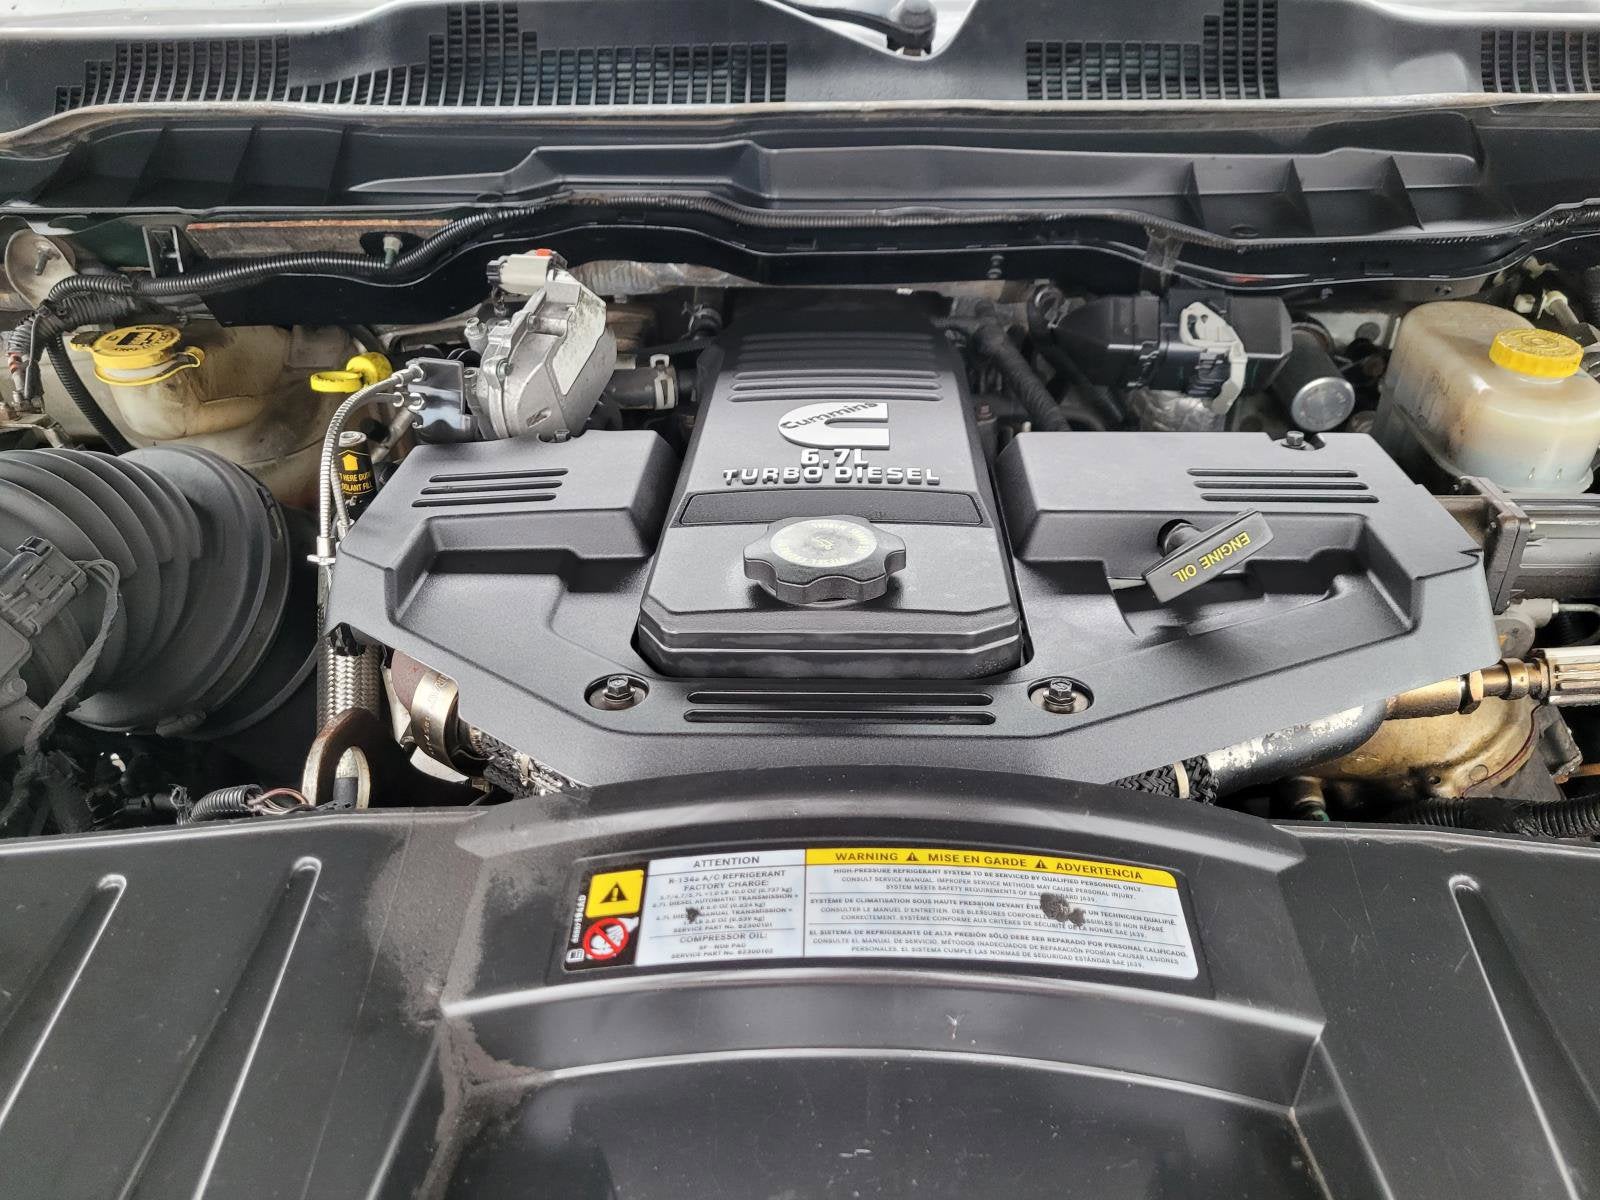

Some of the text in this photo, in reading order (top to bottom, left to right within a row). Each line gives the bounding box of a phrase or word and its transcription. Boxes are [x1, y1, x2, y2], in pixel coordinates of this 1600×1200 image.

[780, 401, 879, 430] Cummins
[801, 449, 868, 468] 6.7L
[723, 467, 940, 486] TURBO DIESEL
[1171, 531, 1251, 582] ENGINE OIL
[693, 856, 760, 868] ATTENTION
[836, 853, 1143, 880] WARNING MISE EN GARDE ADVERTENCIA
[722, 870, 786, 880] REFRIGERANT
[684, 880, 769, 891] FACTORY CHARGE:
[1042, 876, 1079, 885] QUALIFIED
[1081, 880, 1121, 890] PERSONNEL
[965, 886, 1016, 895] REQUIREMENTS
[1076, 888, 1109, 897] PERSONAL
[967, 909, 1005, 917] BLESSURES
[1101, 910, 1141, 921] TECHNICIEN
[1089, 926, 1113, 934] NORME
[680, 933, 745, 943] COMPRESSOR
[1047, 936, 1085, 945] REPARADO
[1105, 942, 1142, 952] PERSONAL
[978, 940, 1027, 949] INADECUADOS
[1118, 952, 1144, 960] CAUSAR
[1146, 956, 1179, 964] LESIONES
